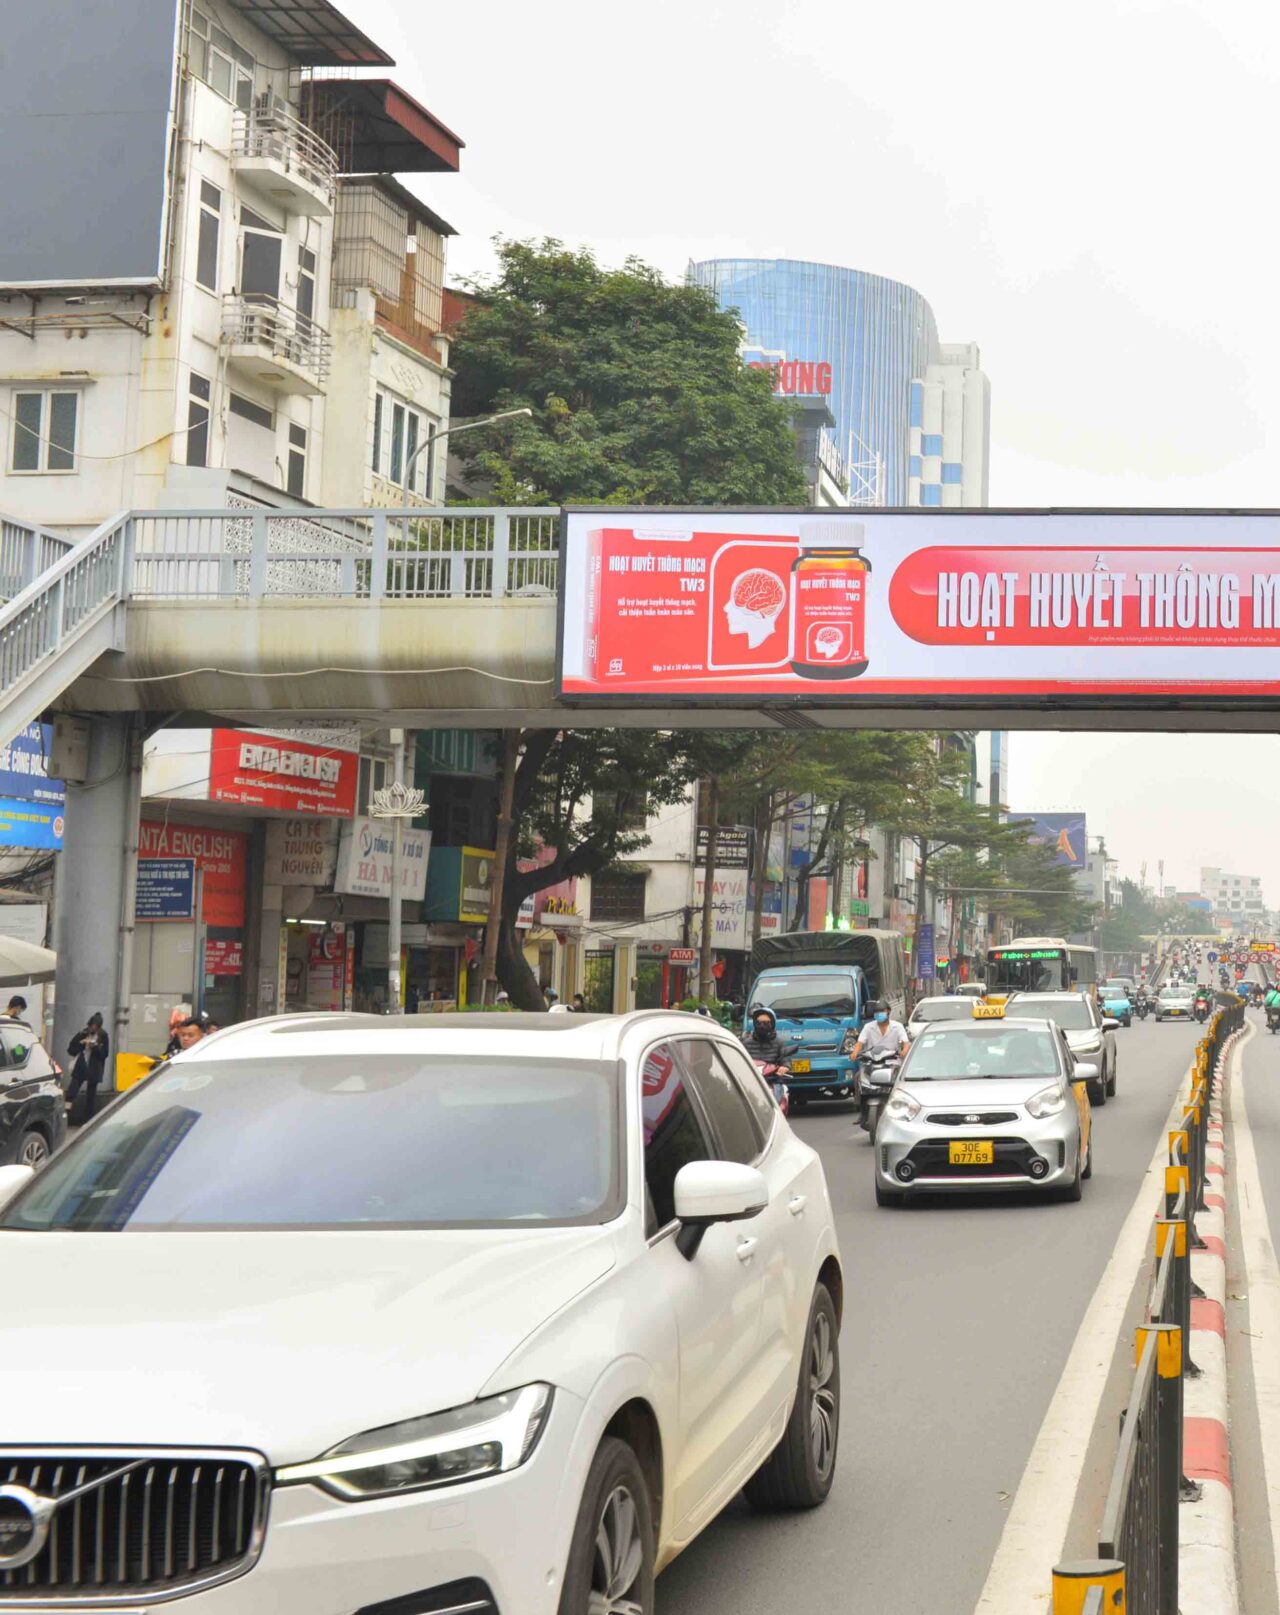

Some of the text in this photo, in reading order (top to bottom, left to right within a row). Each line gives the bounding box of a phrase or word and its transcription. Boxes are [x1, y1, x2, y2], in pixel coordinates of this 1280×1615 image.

[609, 552, 706, 576] HOẠT HUYẾT THÔNG MẠCH
[680, 578, 705, 592] TW3
[937, 572, 1019, 640] HOẠT
[1029, 554, 1126, 628] HUYẾT
[1136, 563, 1240, 629] THÔNG
[239, 743, 341, 783] ENTA ENGLISH
[139, 826, 233, 859] NTA ENGLISH
[357, 854, 378, 882] HÀ
[382, 864, 409, 886] NI
[977, 1008, 1001, 1016] TAXI
[953, 1153, 988, 1163] 077.69
[961, 1143, 980, 1152] 30E
